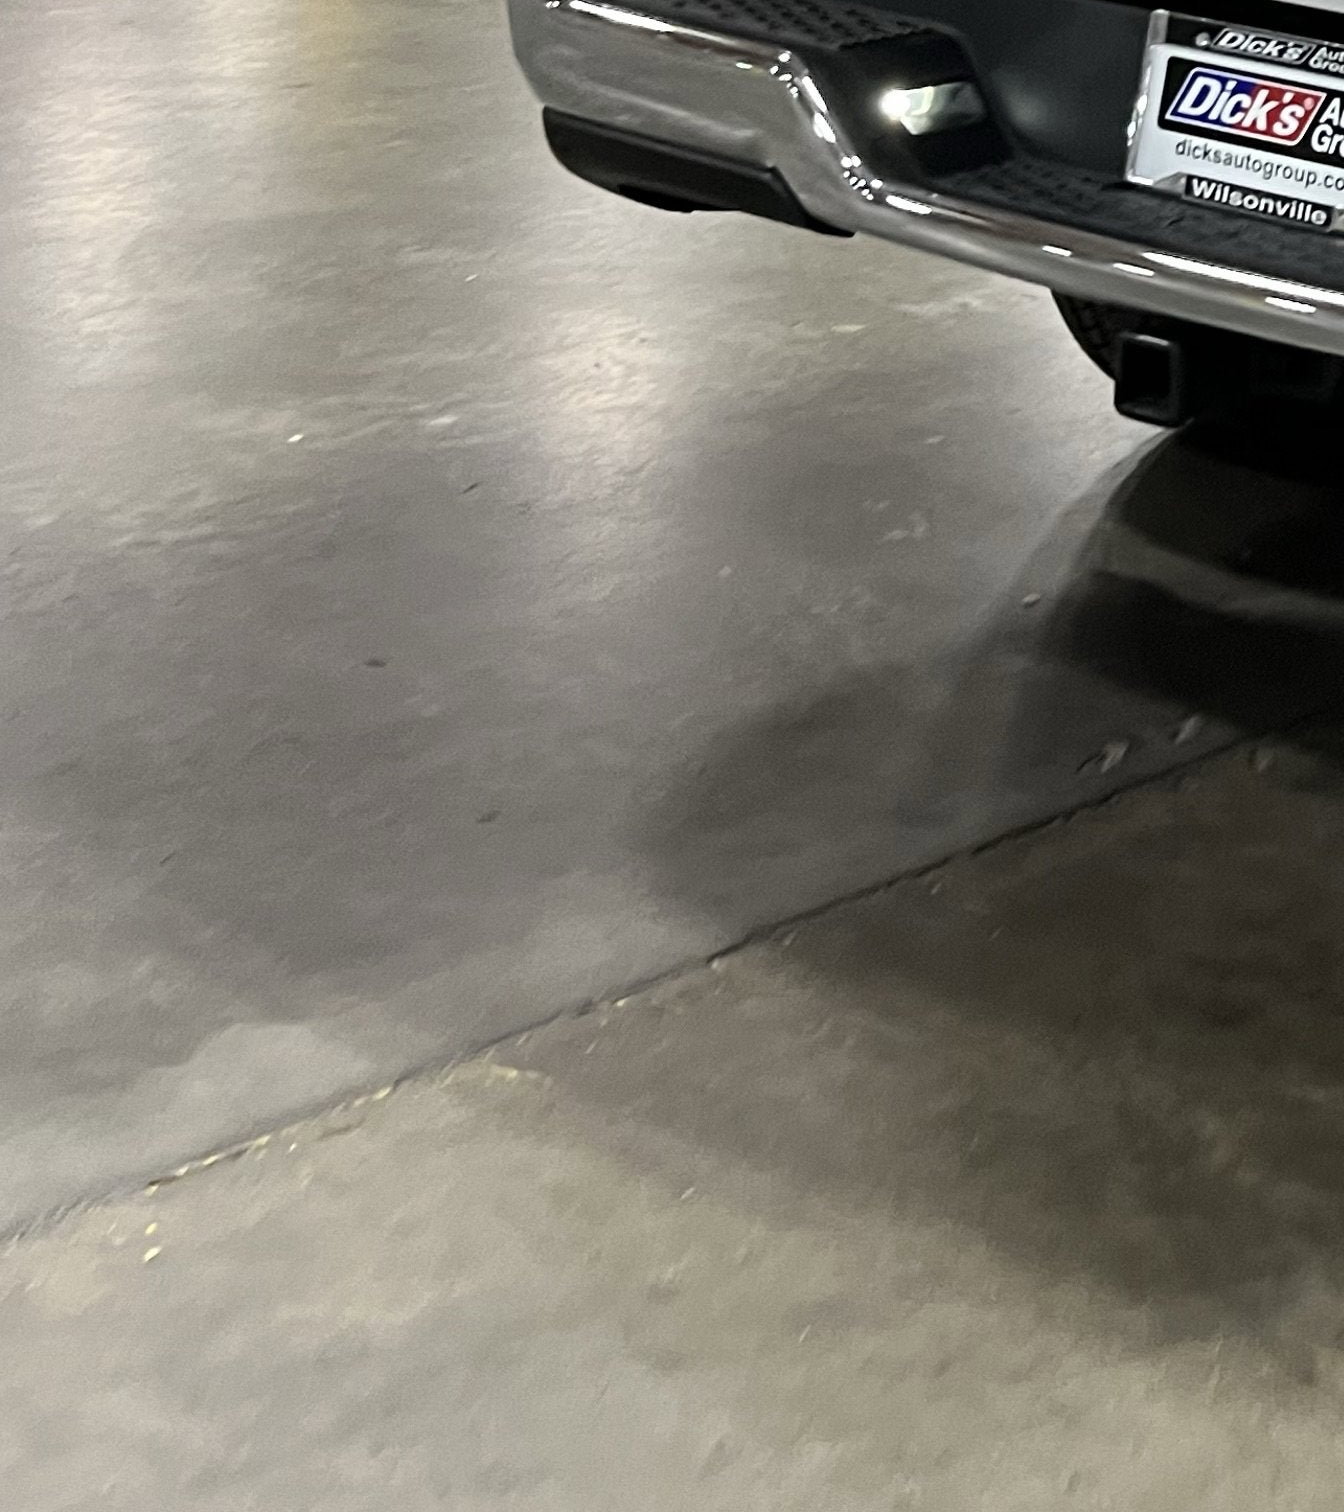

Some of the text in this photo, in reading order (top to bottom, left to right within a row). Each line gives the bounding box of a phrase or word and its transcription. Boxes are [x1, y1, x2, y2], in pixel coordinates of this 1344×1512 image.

[1218, 31, 1304, 60] Dick's
[1177, 76, 1306, 136] Dick's
[1191, 178, 1328, 226] Wilsonville
